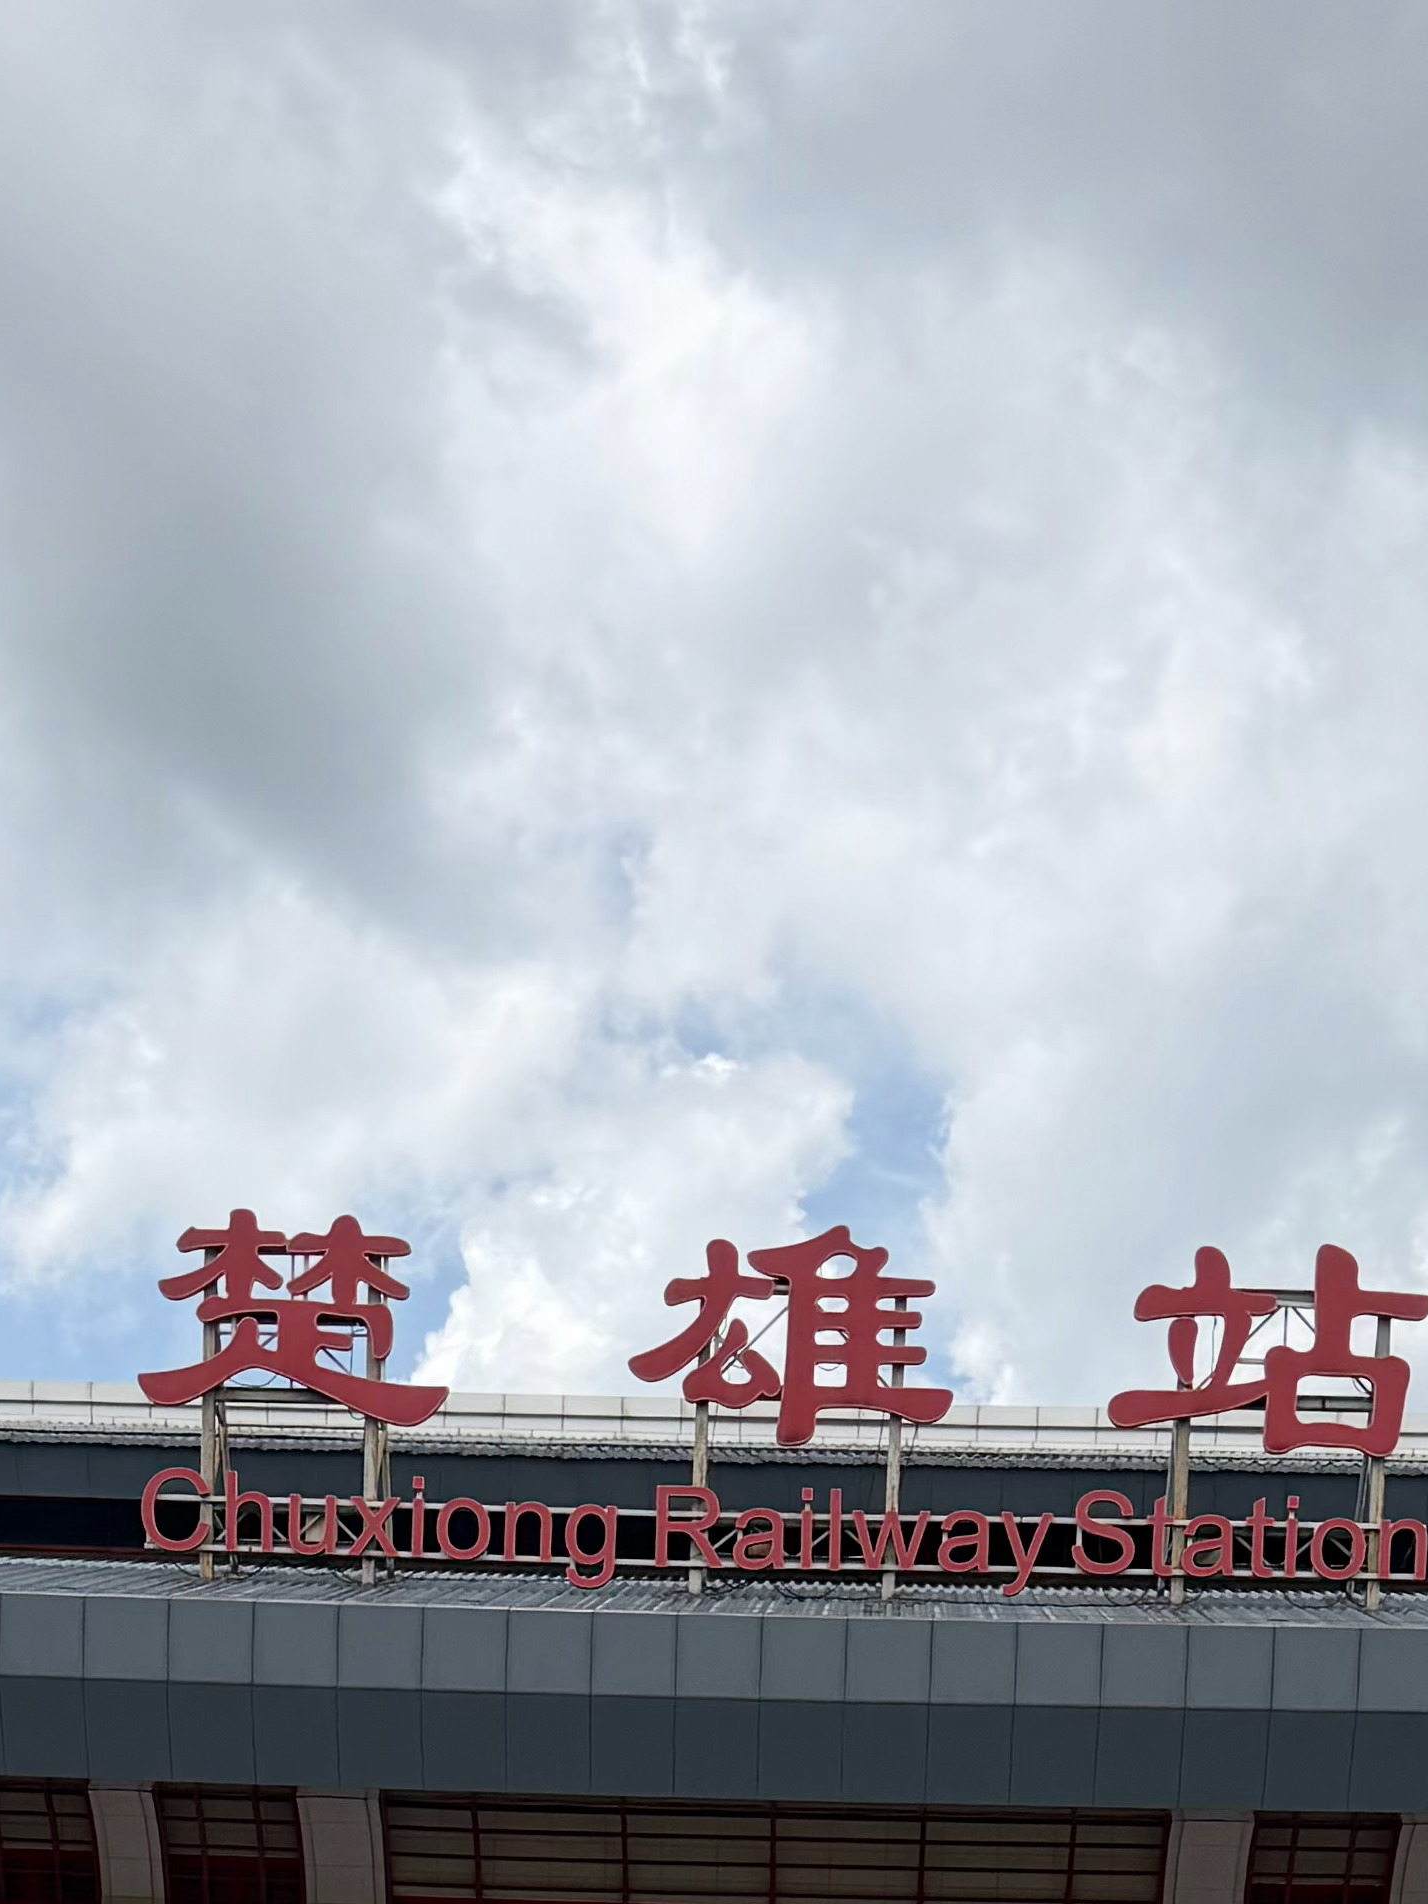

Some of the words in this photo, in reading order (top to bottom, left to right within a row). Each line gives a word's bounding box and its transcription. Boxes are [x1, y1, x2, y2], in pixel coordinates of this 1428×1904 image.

[141, 1467, 618, 1589] Chuxiong
[654, 1485, 1054, 1596] Railway
[1073, 1489, 1428, 1583] Station
